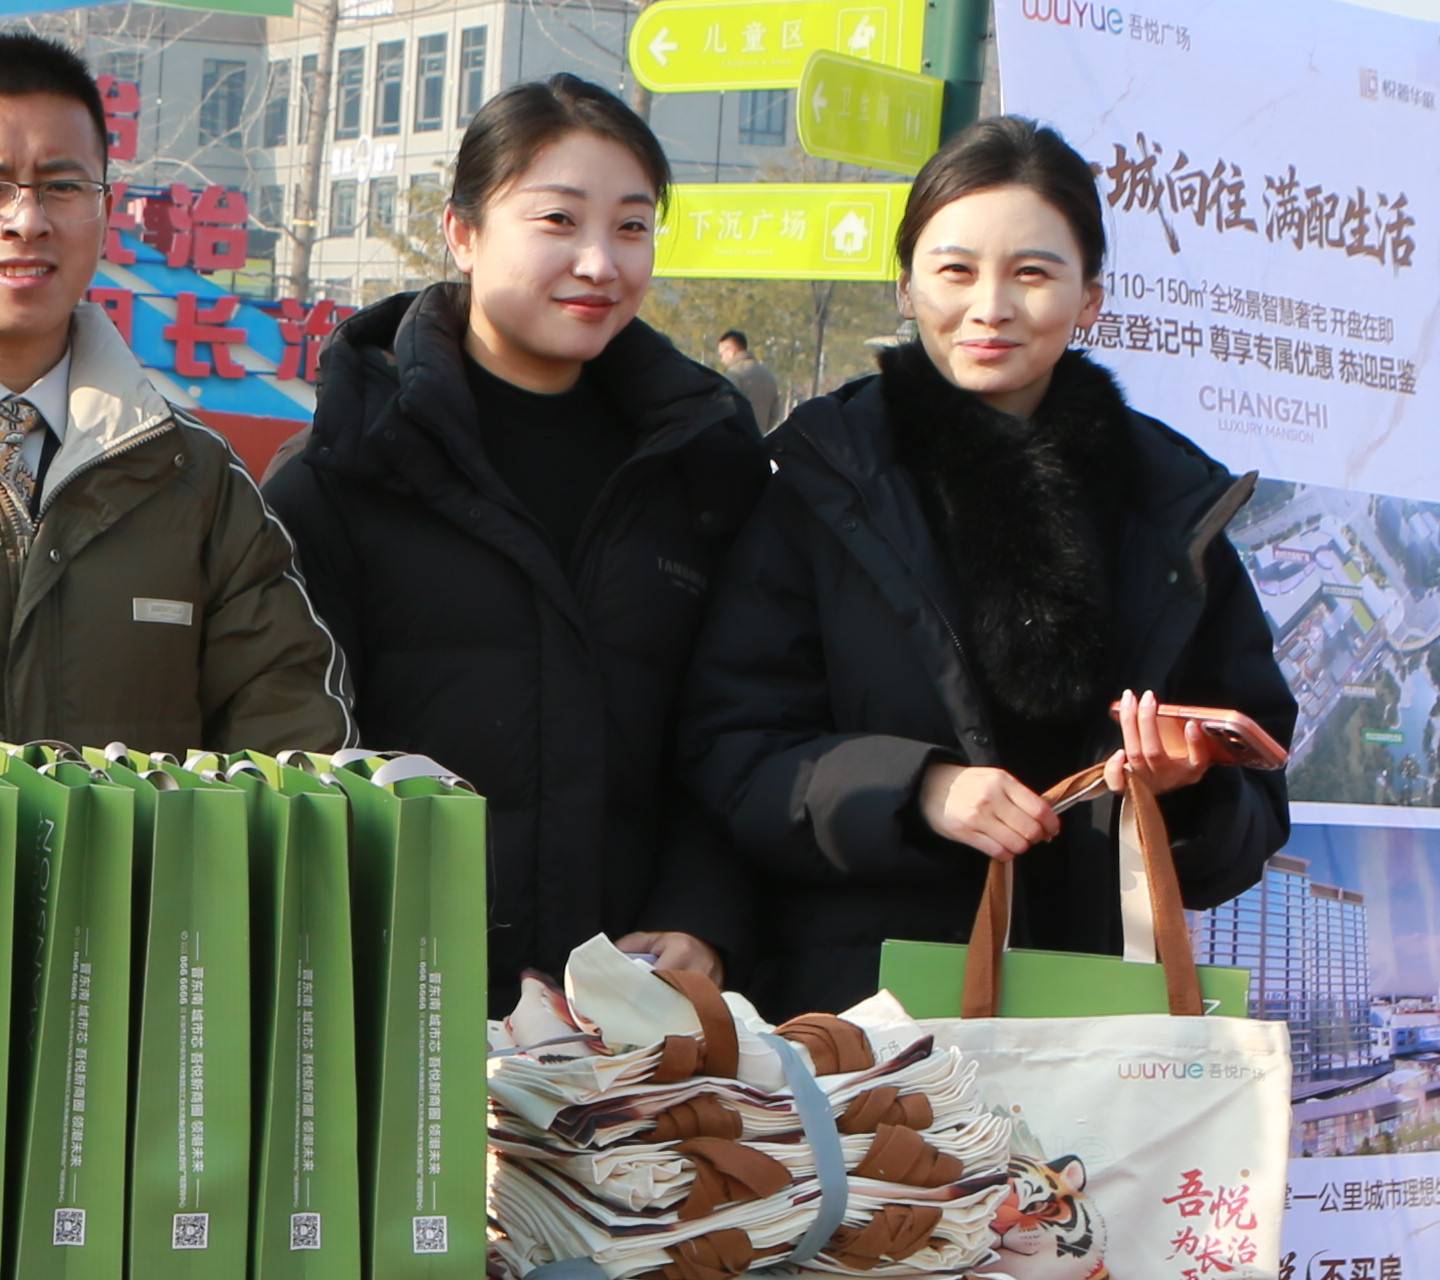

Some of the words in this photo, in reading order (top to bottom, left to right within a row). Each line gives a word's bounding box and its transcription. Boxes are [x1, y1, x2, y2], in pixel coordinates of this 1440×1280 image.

[703, 19, 806, 54] 儿童区
[1128, 12, 1192, 53] 吾悦广场
[1090, 131, 1259, 256] 城向往
[1264, 160, 1418, 270] 满配生活
[687, 209, 808, 241] 下沉广场
[1331, 308, 1395, 344] 开盘在即
[1208, 325, 1335, 381] 尊享专属优惠
[1339, 348, 1417, 396] 恭迎品鉴
[1198, 384, 1329, 430] CHANGZHI
[1217, 418, 1262, 436] LUXURY
[1265, 424, 1315, 444] MANSION
[77, 1005, 89, 1044] 城市芯
[192, 1009, 203, 1049] 城市芯
[429, 1014, 440, 1053] 城市芯
[1209, 1063, 1266, 1082] 吾悦广场
[1162, 1168, 1259, 1231] 吾悦
[1165, 1228, 1259, 1274] 为长治
